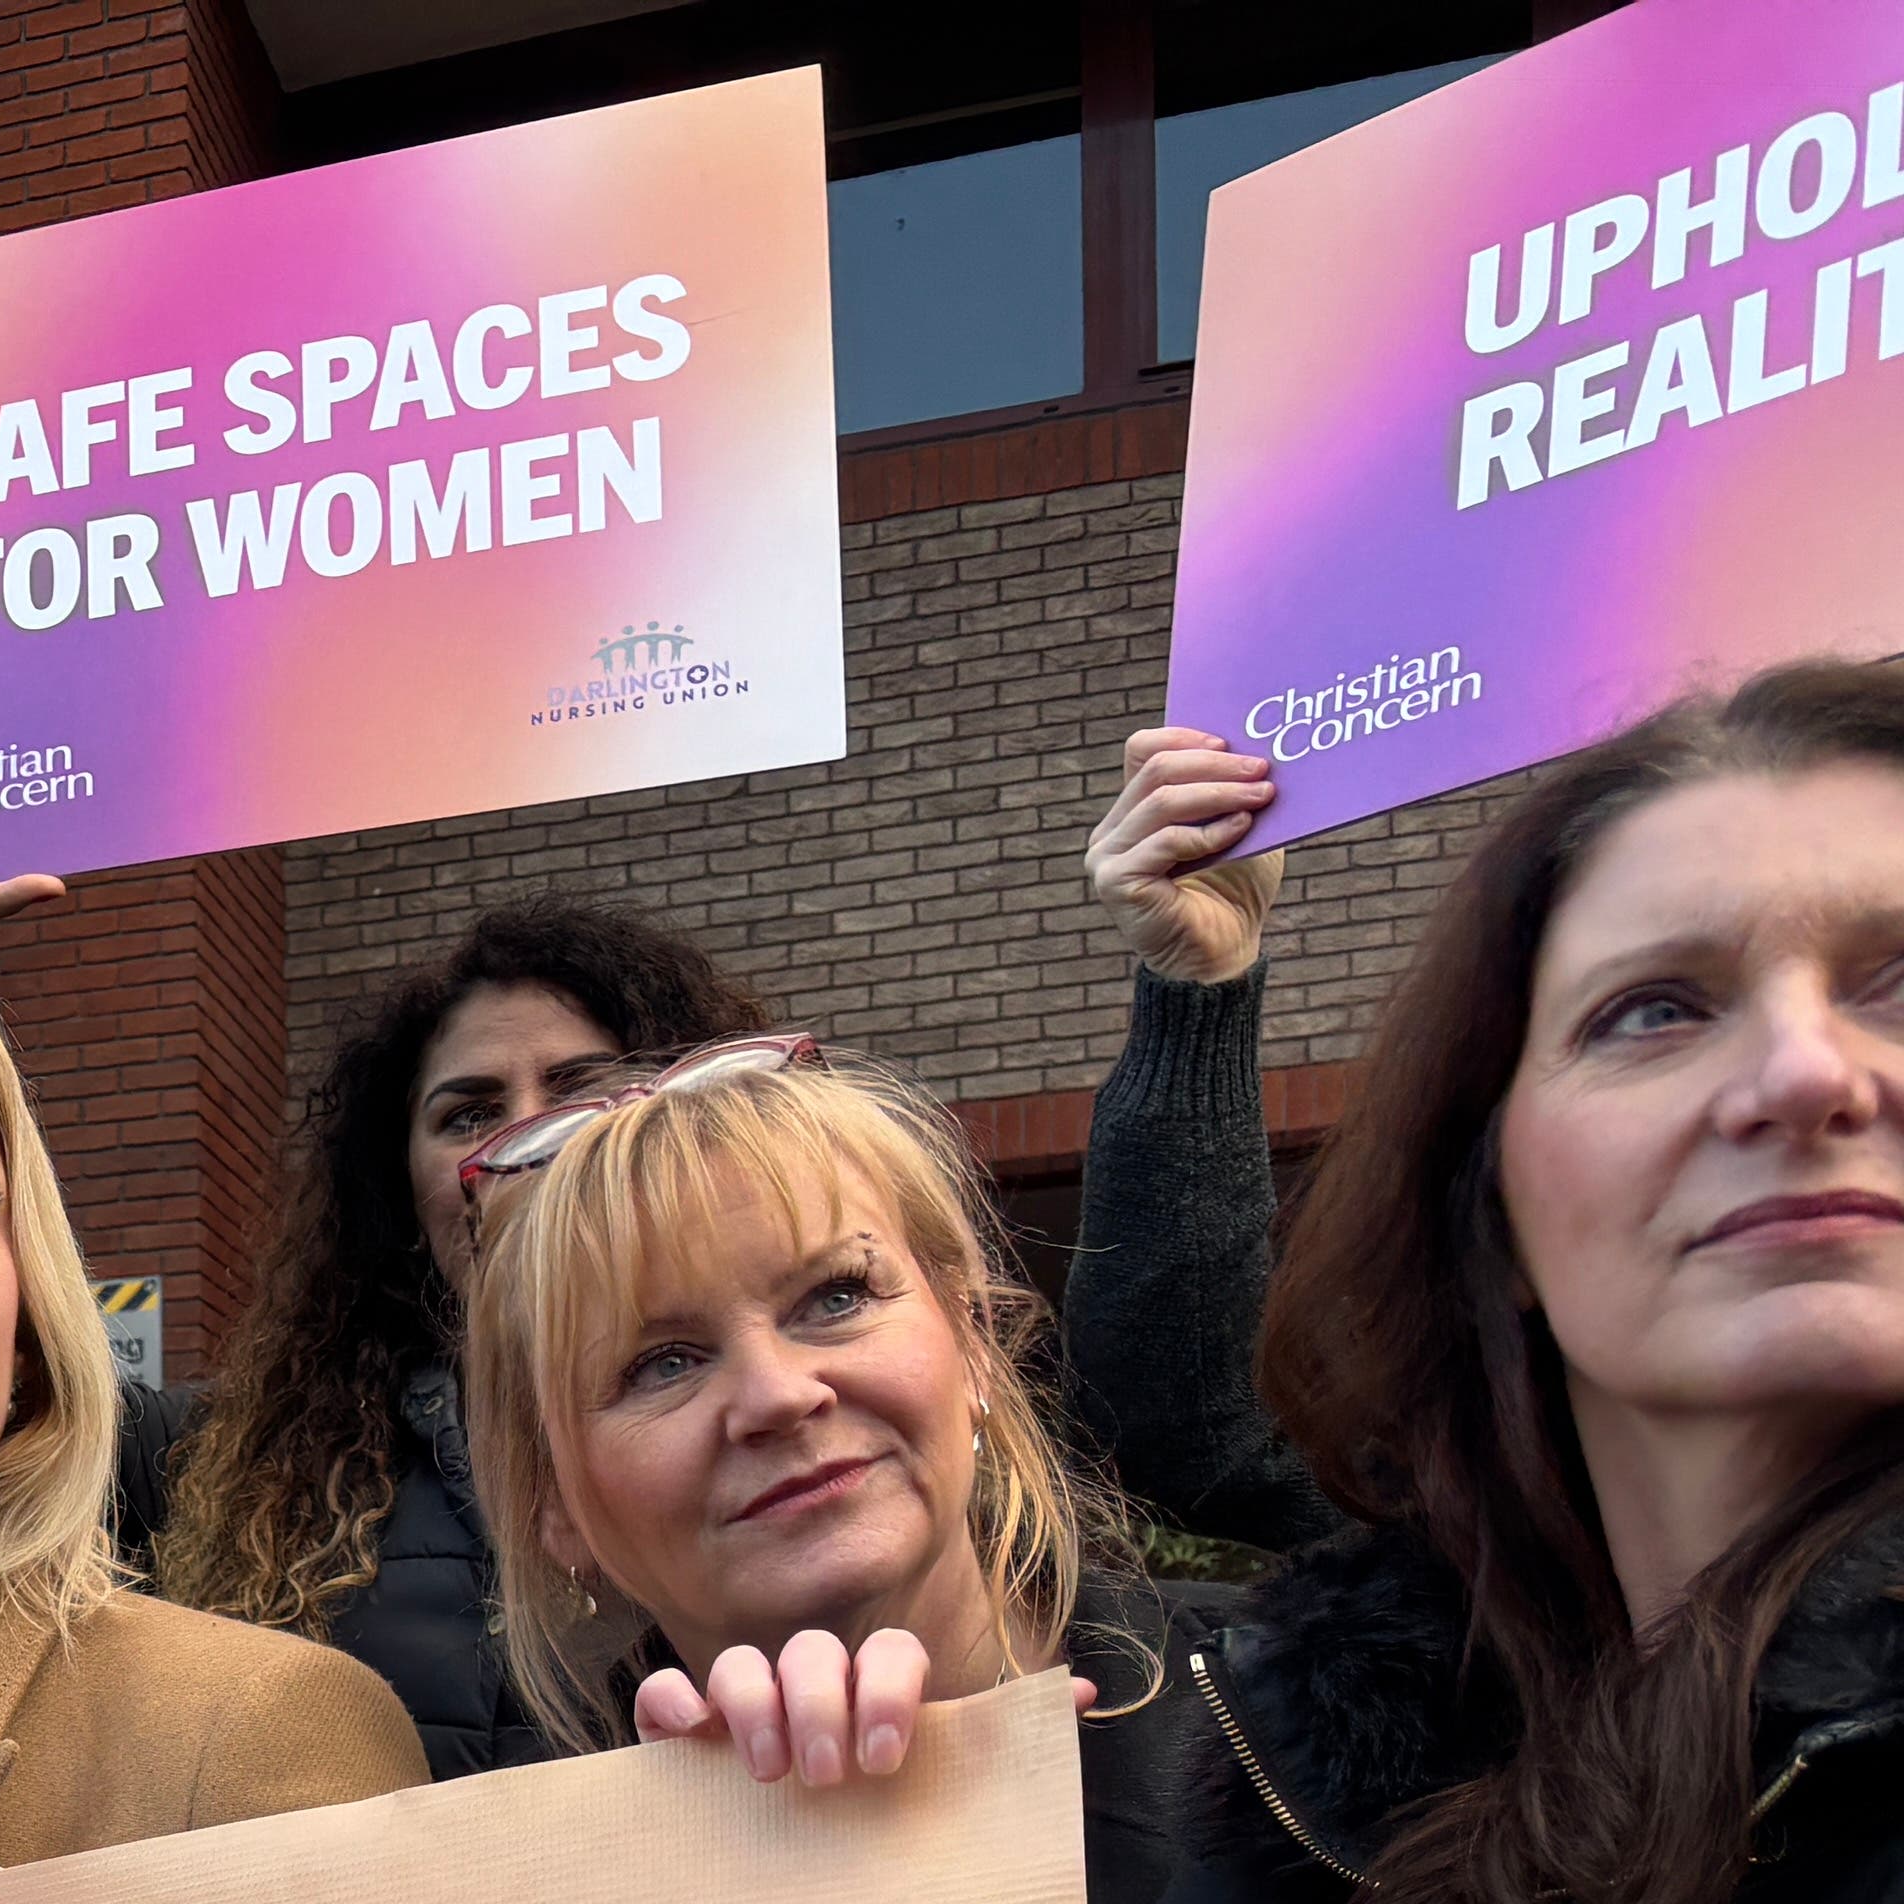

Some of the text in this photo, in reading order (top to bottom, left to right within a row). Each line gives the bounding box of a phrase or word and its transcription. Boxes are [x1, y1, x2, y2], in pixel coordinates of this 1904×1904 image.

[223, 274, 692, 455] SPACES
[185, 416, 664, 598] WOMEN
[530, 680, 749, 726] NURSING UNION
[547, 660, 731, 707] DARLINGTON
[1245, 646, 1461, 740] Christian
[1272, 672, 1482, 762] Concern
